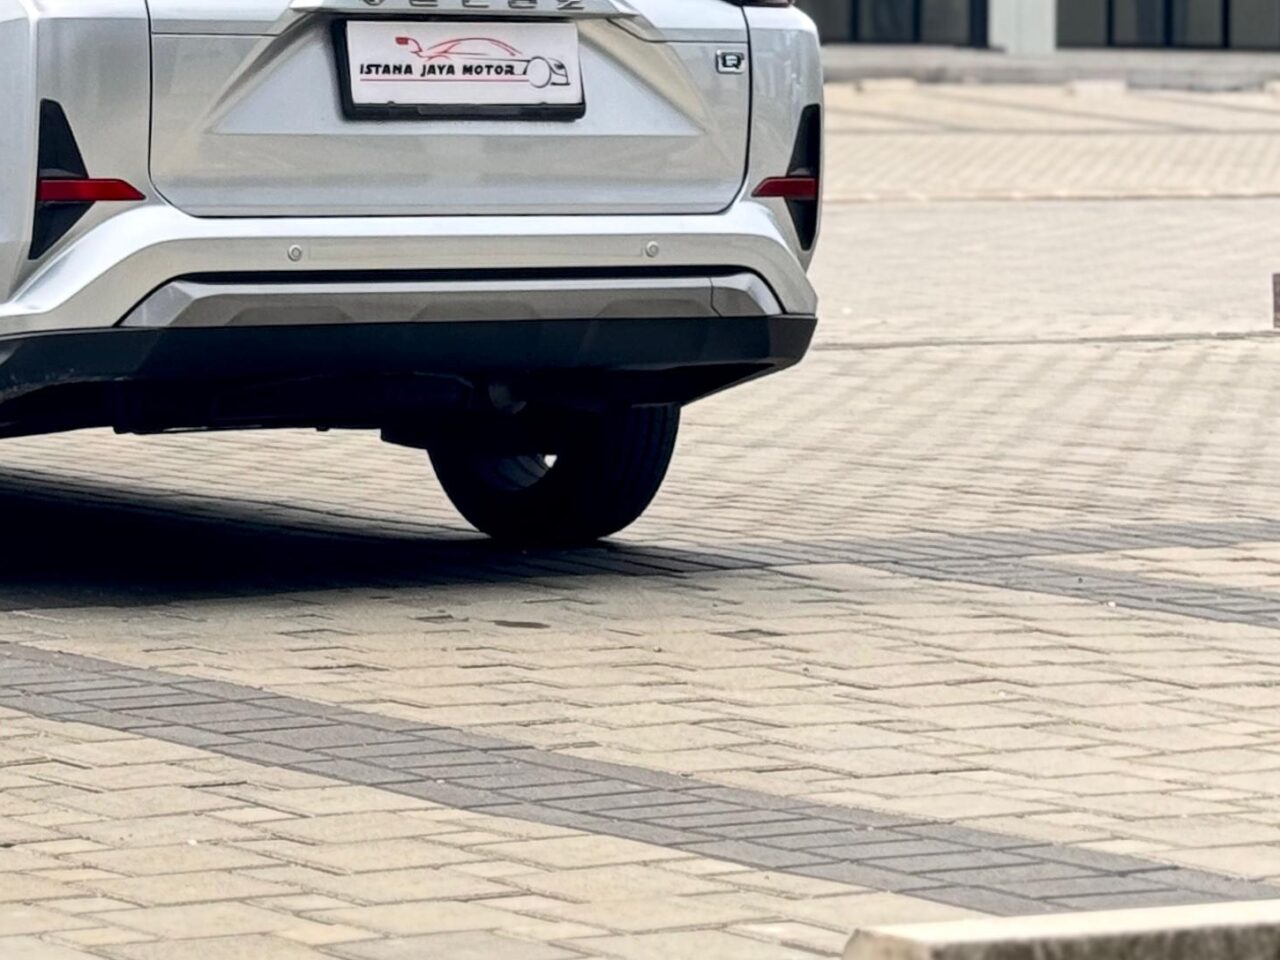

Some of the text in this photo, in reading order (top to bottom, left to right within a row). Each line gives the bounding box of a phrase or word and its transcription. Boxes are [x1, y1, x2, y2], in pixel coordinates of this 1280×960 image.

[359, 63, 516, 78] ISTANA JAYA MOTOR
